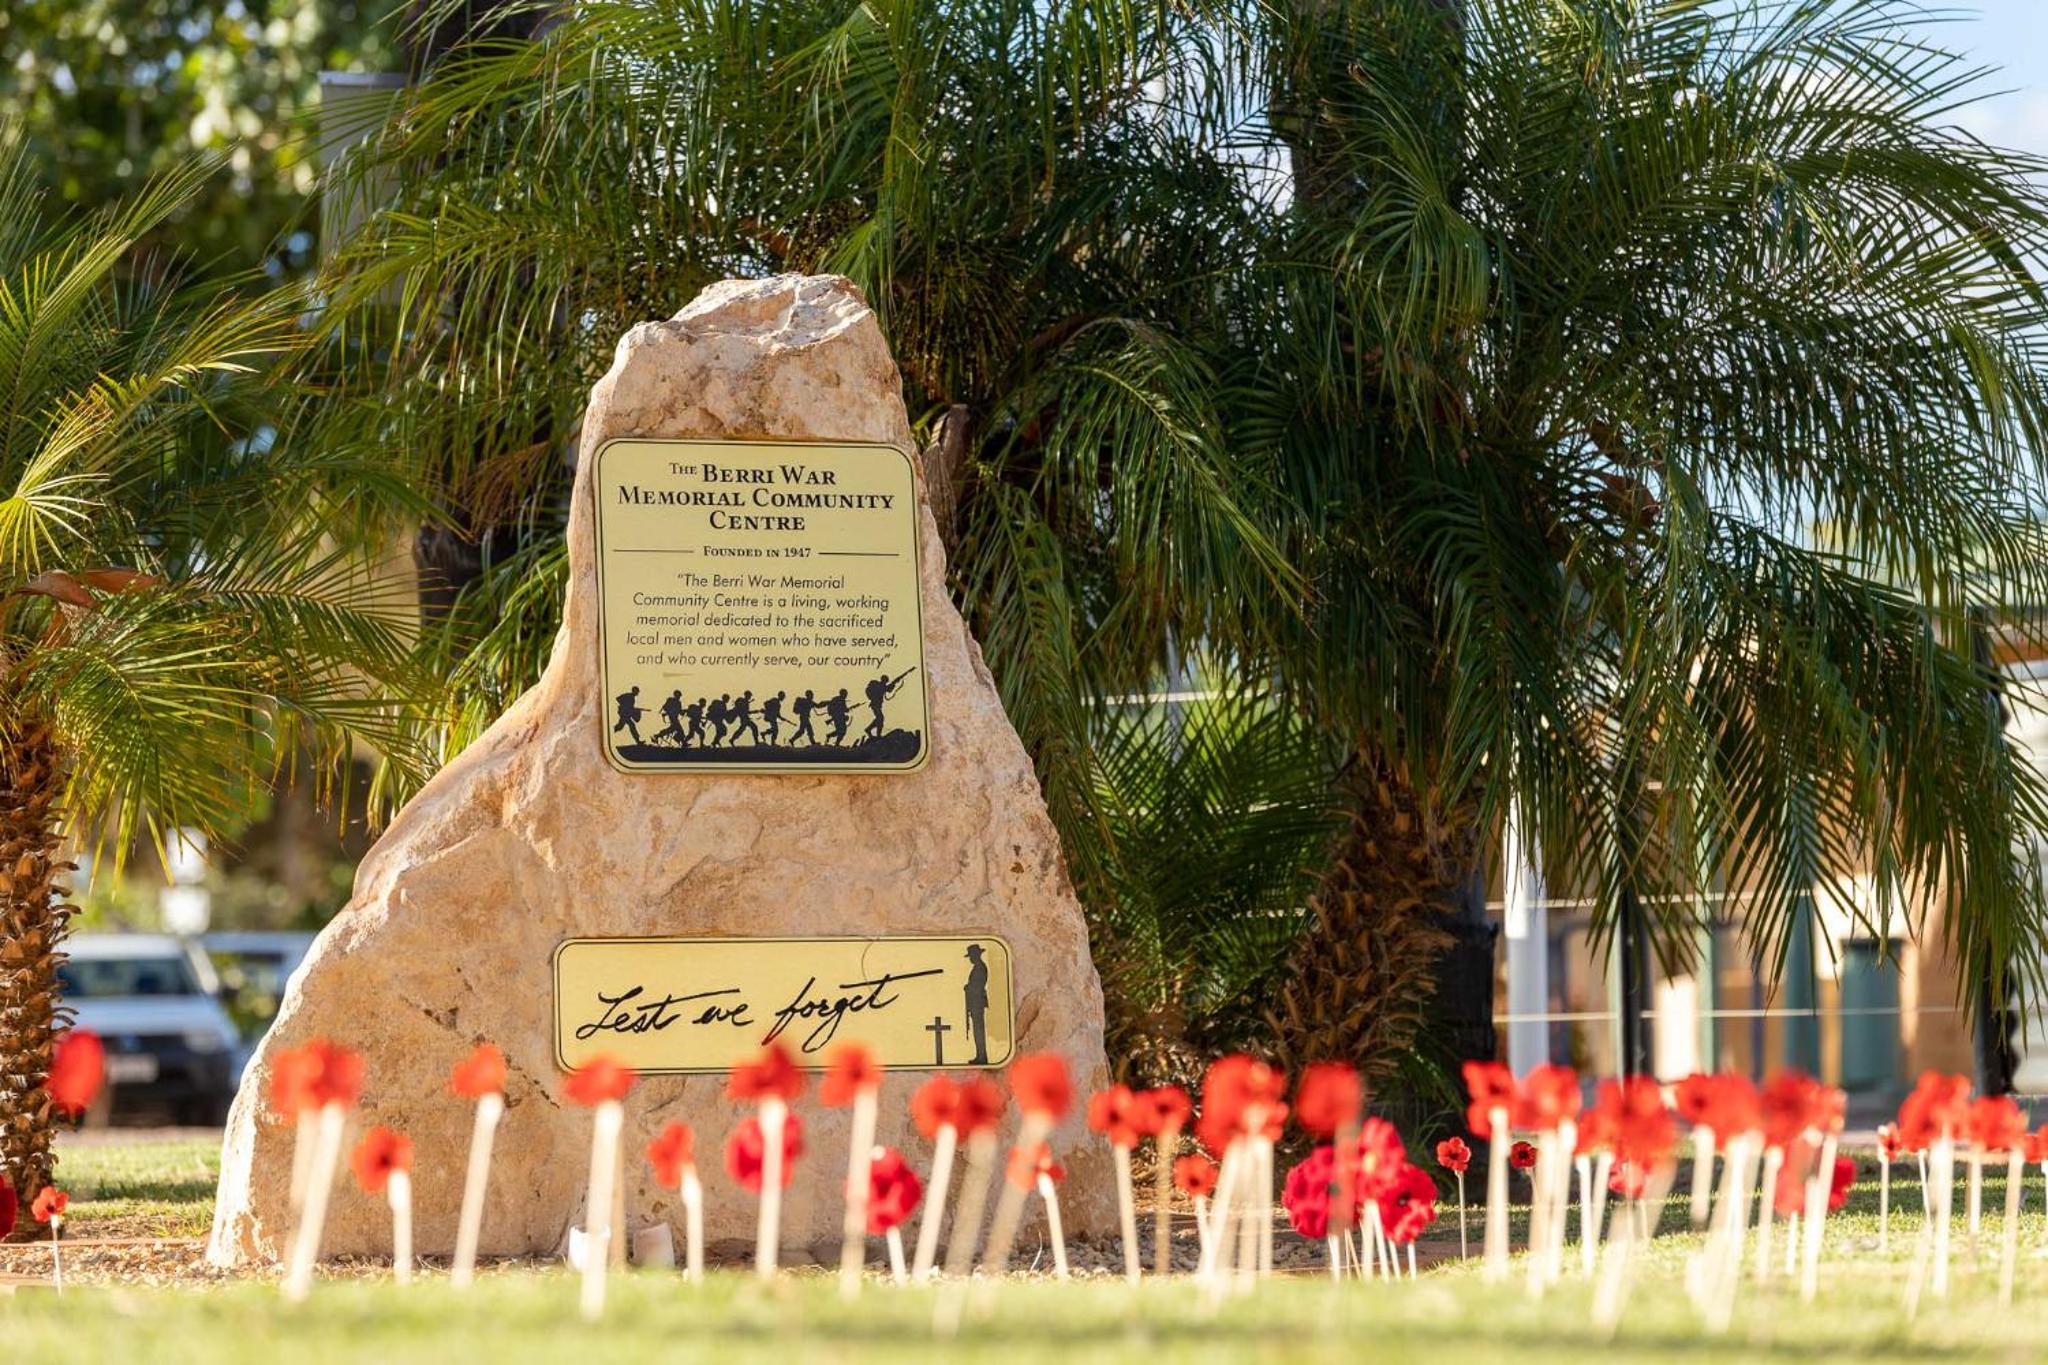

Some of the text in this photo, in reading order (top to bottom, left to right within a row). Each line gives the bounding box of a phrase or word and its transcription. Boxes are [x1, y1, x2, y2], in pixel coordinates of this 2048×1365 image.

[670, 463, 836, 485] THE BERRI WAR
[618, 486, 895, 509] MEMORIAL COMMUNITY
[710, 511, 805, 531] CENTRE
[704, 546, 811, 557] FOUNDED IN 1947
[713, 575, 743, 588] Berri
[748, 576, 776, 588] War
[781, 576, 844, 589] Memorial
[633, 593, 888, 611] Community Centre is a living, working
[636, 614, 883, 628] memorial dedicated to the sacrificed
[627, 633, 898, 649] local men and women who have served,
[637, 653, 663, 665] and
[668, 653, 696, 665] who
[701, 653, 759, 669] currently
[764, 655, 802, 668] serve,
[808, 655, 829, 666] our
[576, 969, 943, 1053] Lest we forget
